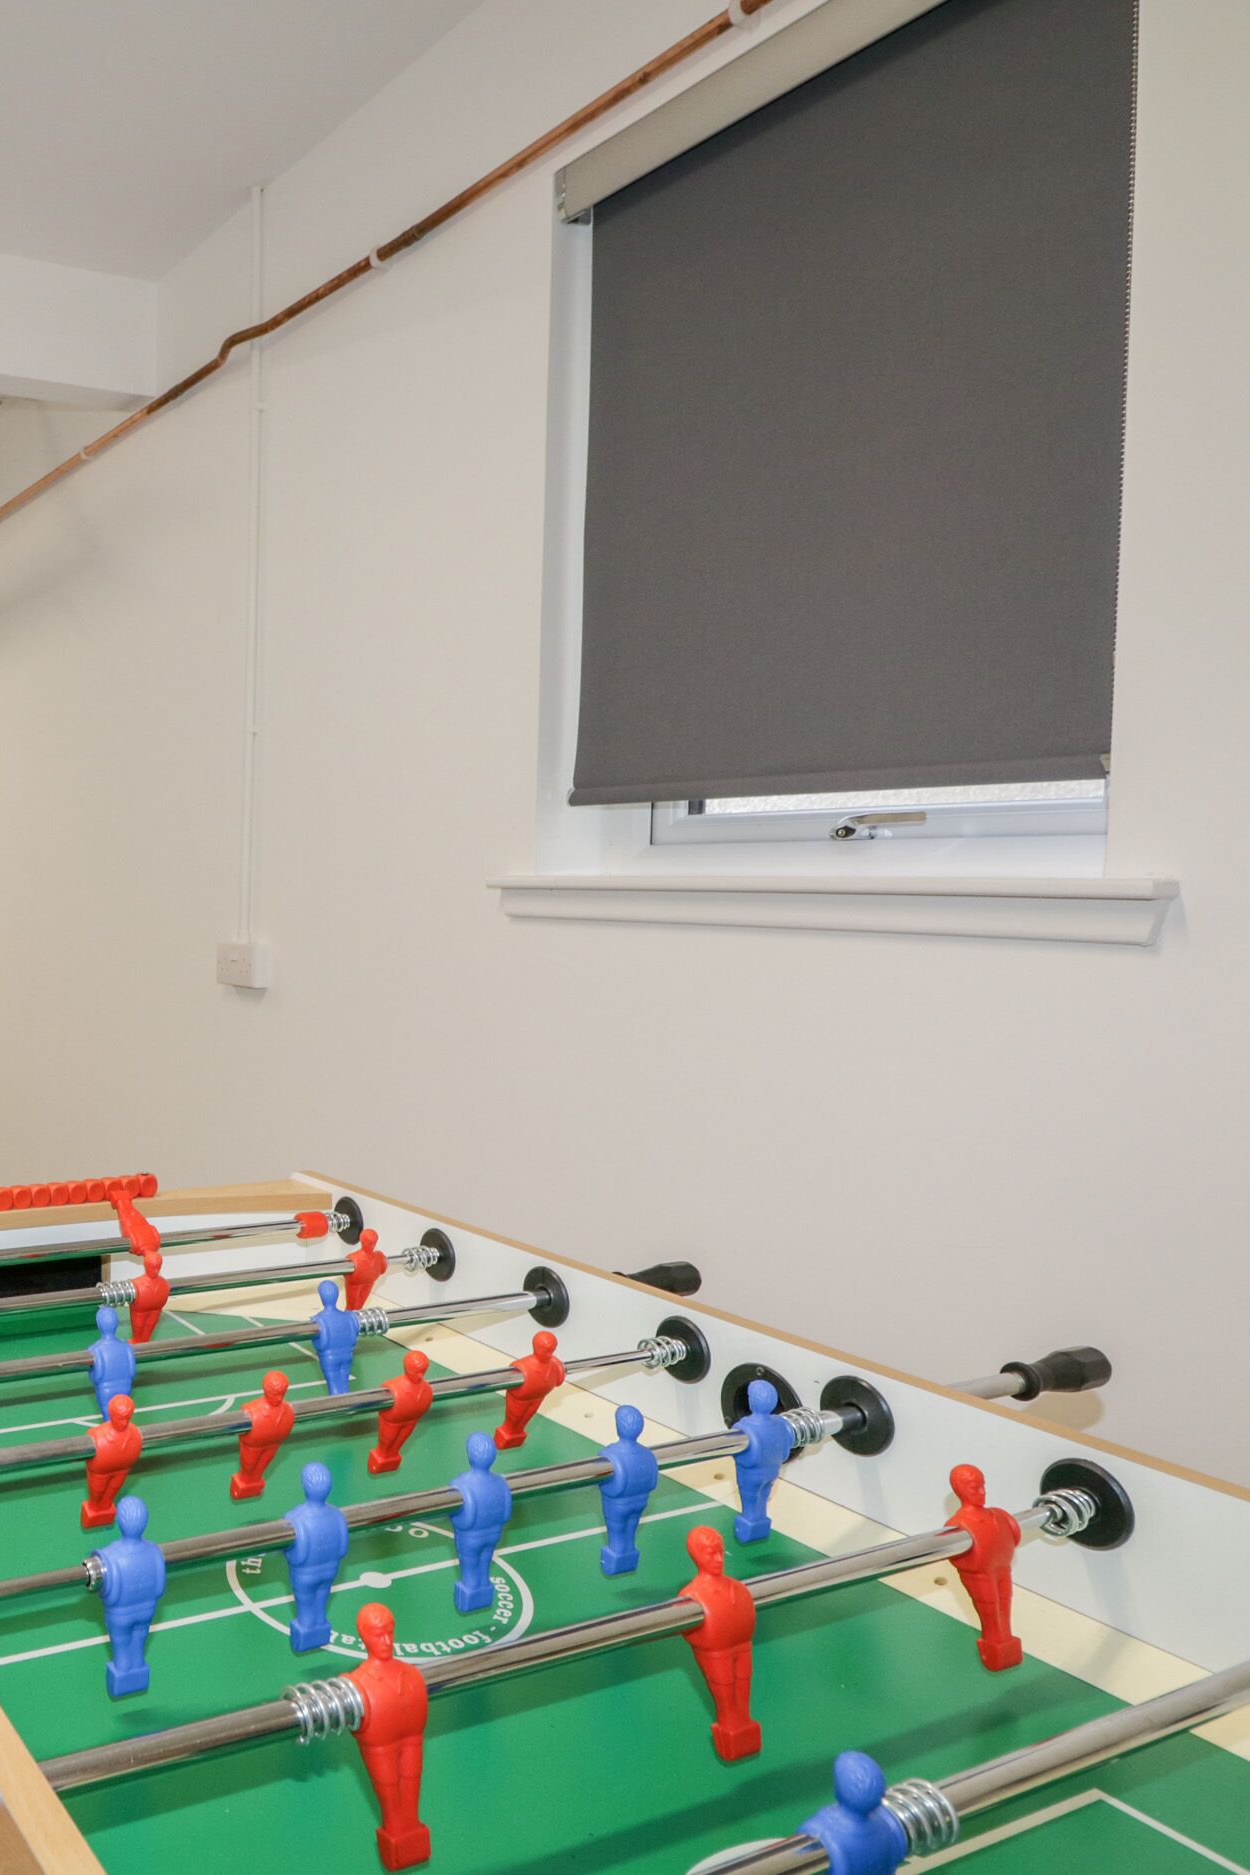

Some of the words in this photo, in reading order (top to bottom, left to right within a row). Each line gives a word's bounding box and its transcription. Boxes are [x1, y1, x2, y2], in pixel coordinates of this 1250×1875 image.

[240, 1554, 264, 1575] th
[488, 1576, 514, 1625] soccer
[393, 1630, 492, 1656] footbal
